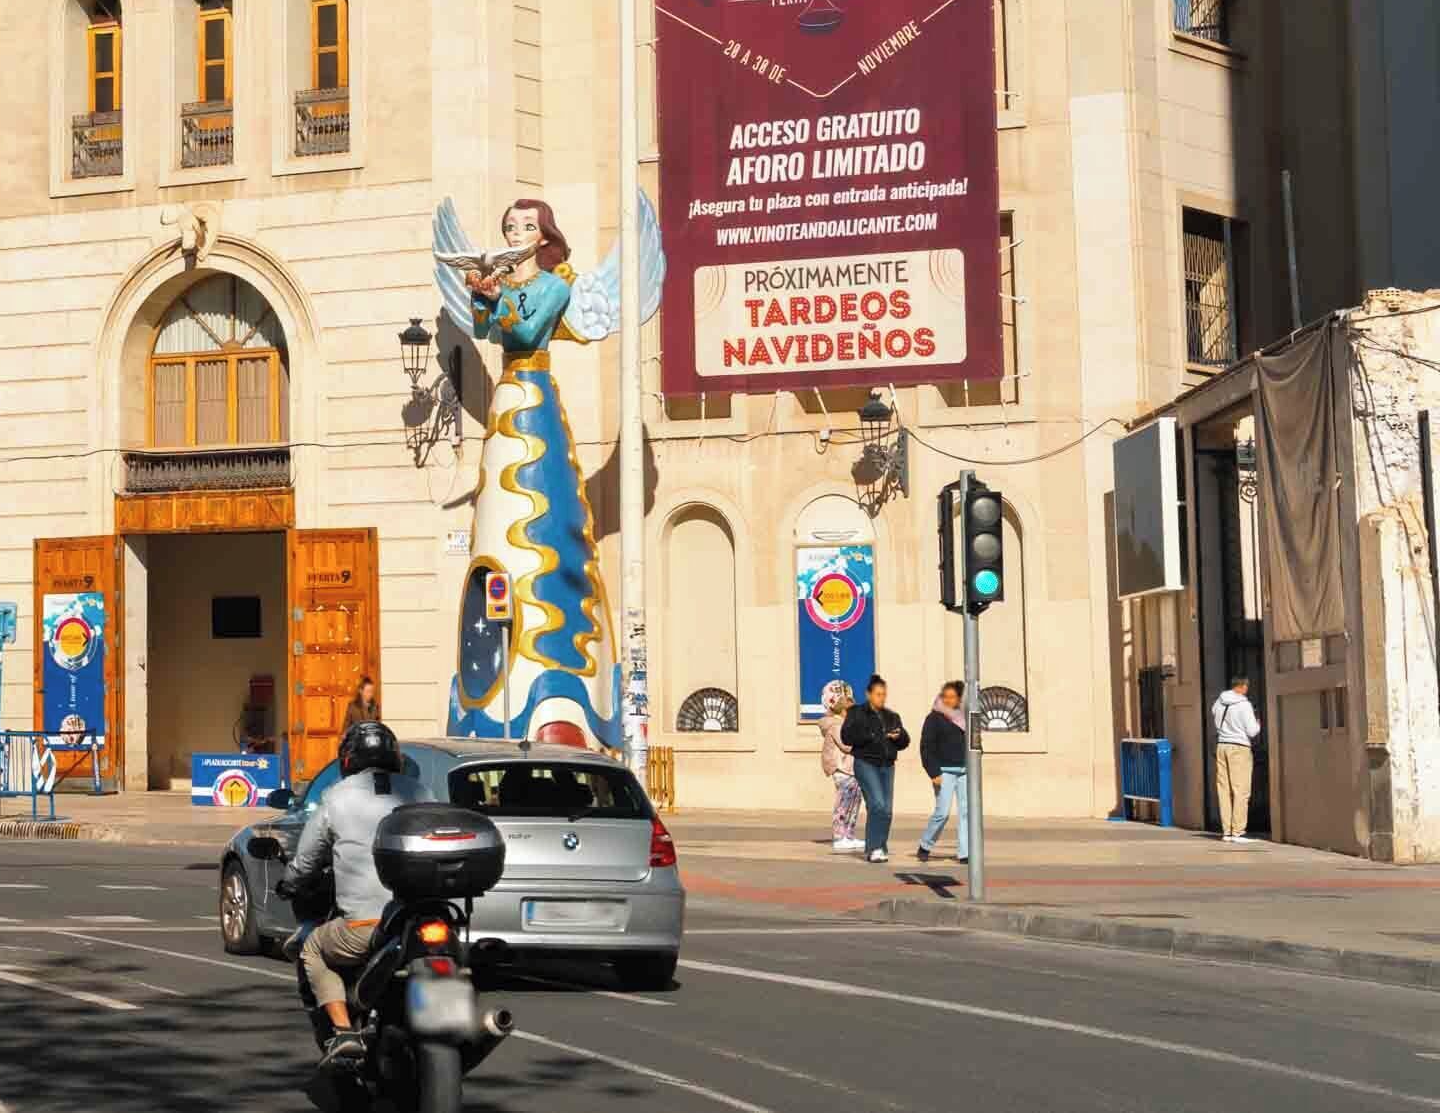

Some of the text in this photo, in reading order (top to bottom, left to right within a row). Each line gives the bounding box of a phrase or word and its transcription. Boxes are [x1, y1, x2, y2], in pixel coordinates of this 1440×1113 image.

[740, 49, 751, 66] A
[752, 55, 768, 74] 30
[768, 64, 787, 84] DE
[857, 20, 922, 76] NOVIEMBRE
[729, 108, 920, 150] ACCESO GRATUITO
[726, 141, 925, 186] AFORO LIMITADO
[688, 177, 968, 219] ¡Asegura tu plaza con entrada anticipada!
[716, 213, 937, 246] WWW.VINOTEANDOALICANTE.COM
[744, 260, 909, 293] PRÓXIMAMENTE
[744, 289, 912, 328] TARDEOS
[723, 322, 937, 368] NAVIDEÑOS
